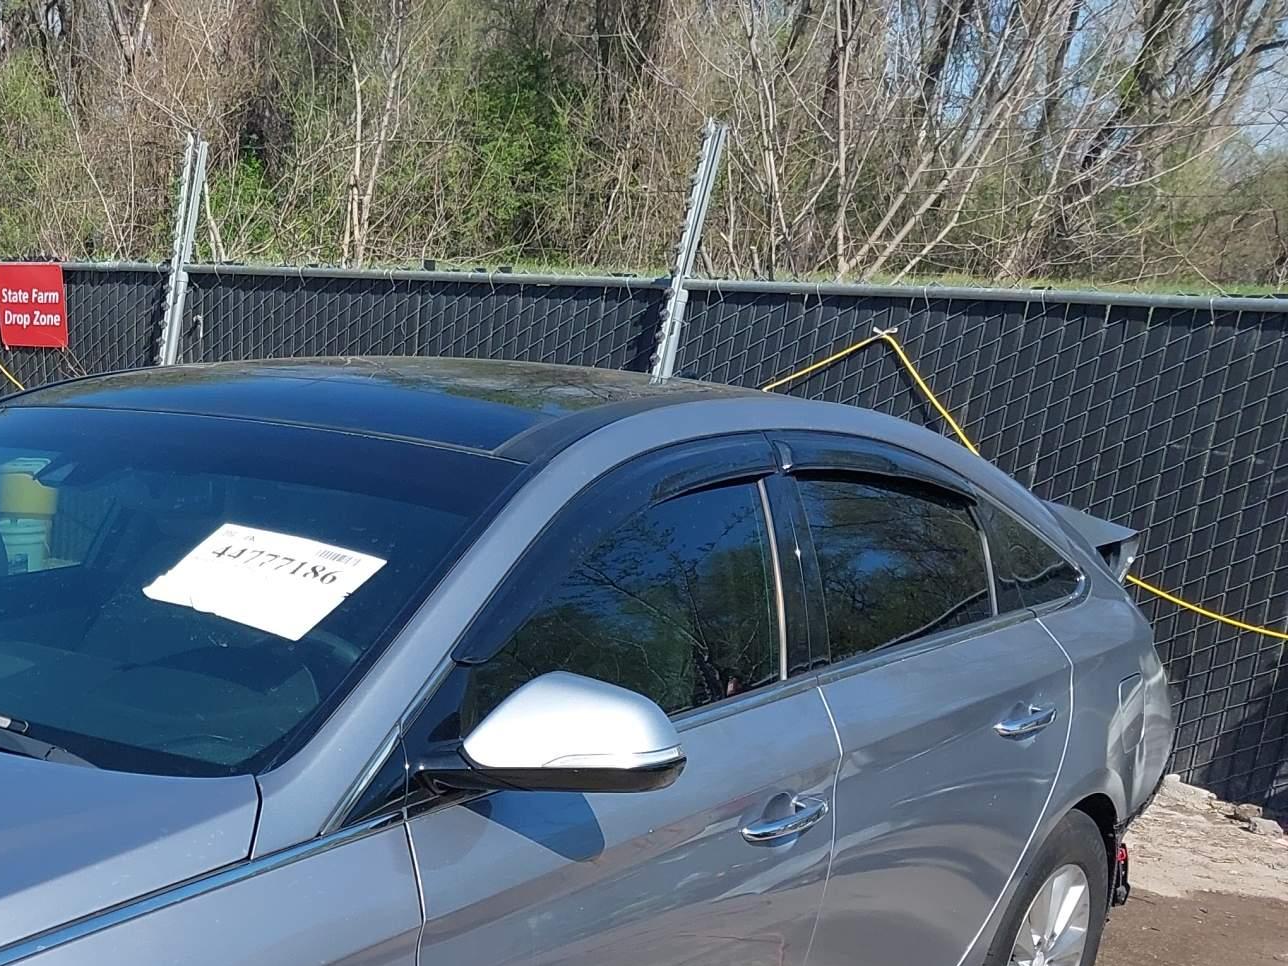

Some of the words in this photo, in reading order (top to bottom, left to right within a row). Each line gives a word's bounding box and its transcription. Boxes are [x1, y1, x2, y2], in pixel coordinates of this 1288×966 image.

[1, 288, 29, 304] State
[31, 288, 60, 304] Farm
[4, 310, 31, 329] Drop
[32, 310, 61, 326] Zone
[212, 545, 343, 585] 44777186
